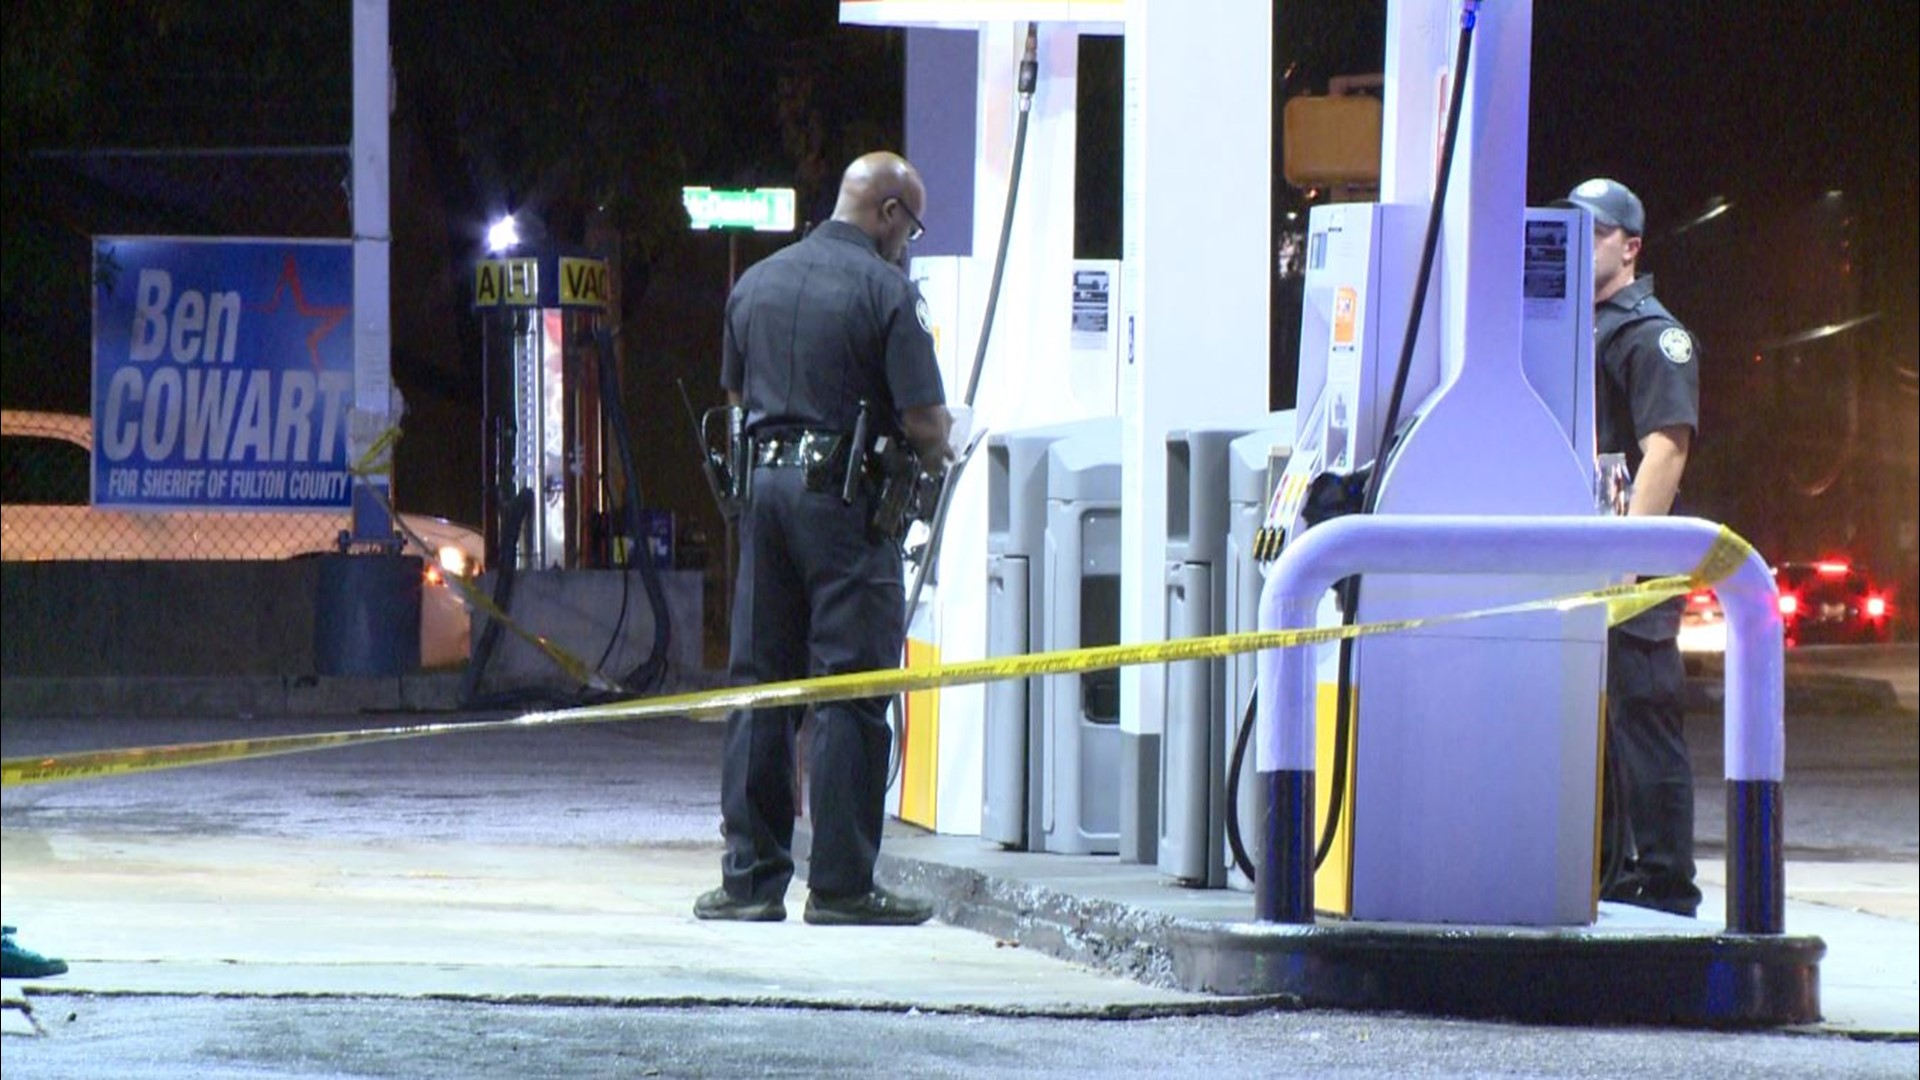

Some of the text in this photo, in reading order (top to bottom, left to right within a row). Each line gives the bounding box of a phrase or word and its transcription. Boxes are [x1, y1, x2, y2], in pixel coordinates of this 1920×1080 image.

[130, 268, 242, 363] Ben
[103, 366, 350, 463] COWART
[109, 469, 349, 500] FOR SHERIFF OF FULTON COUNTY
